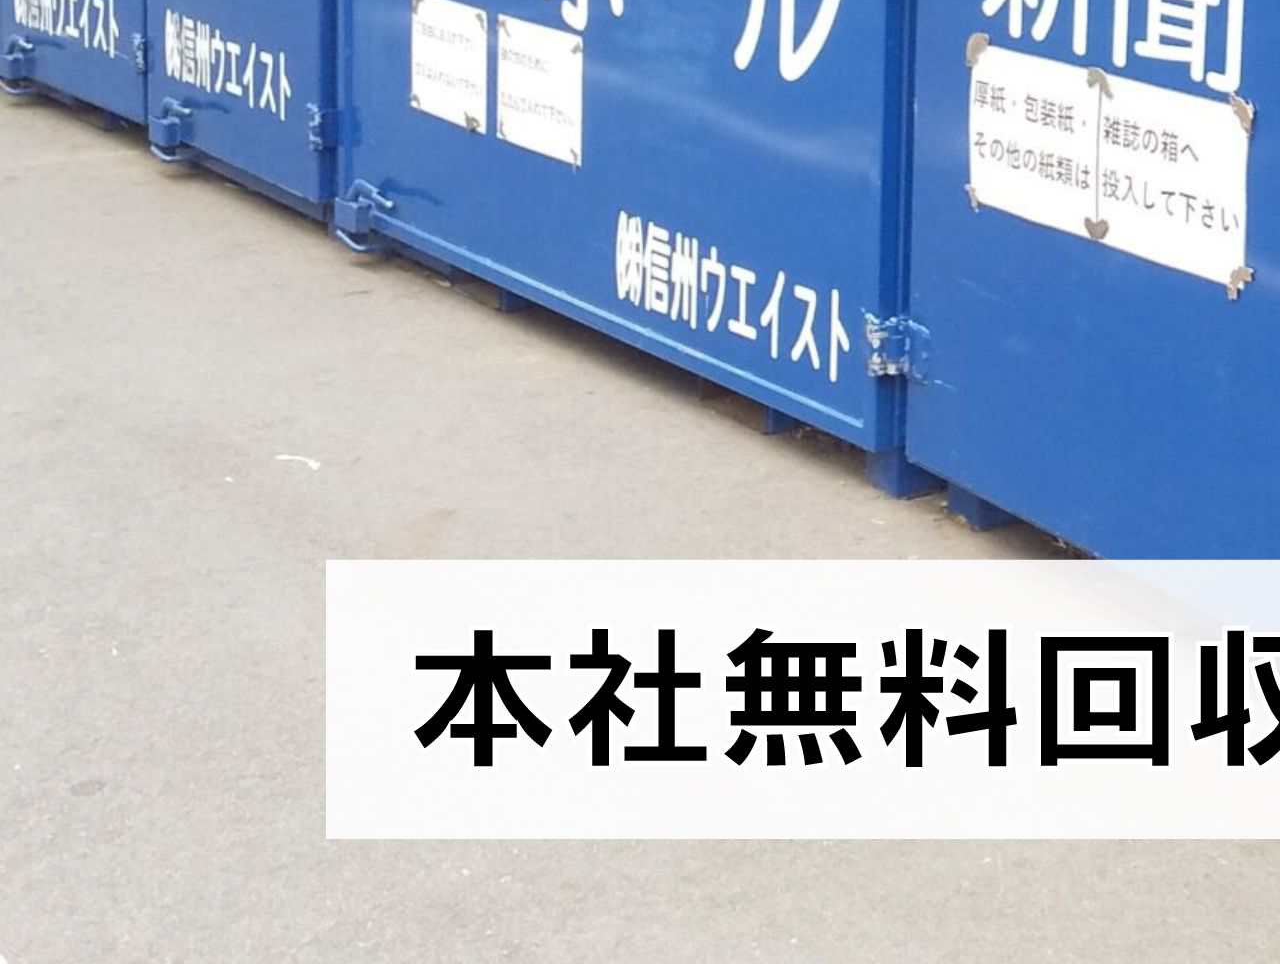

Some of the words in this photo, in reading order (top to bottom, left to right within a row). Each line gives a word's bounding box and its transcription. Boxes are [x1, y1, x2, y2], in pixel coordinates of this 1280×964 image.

[1102, 168, 1239, 232] 投入して下さい
